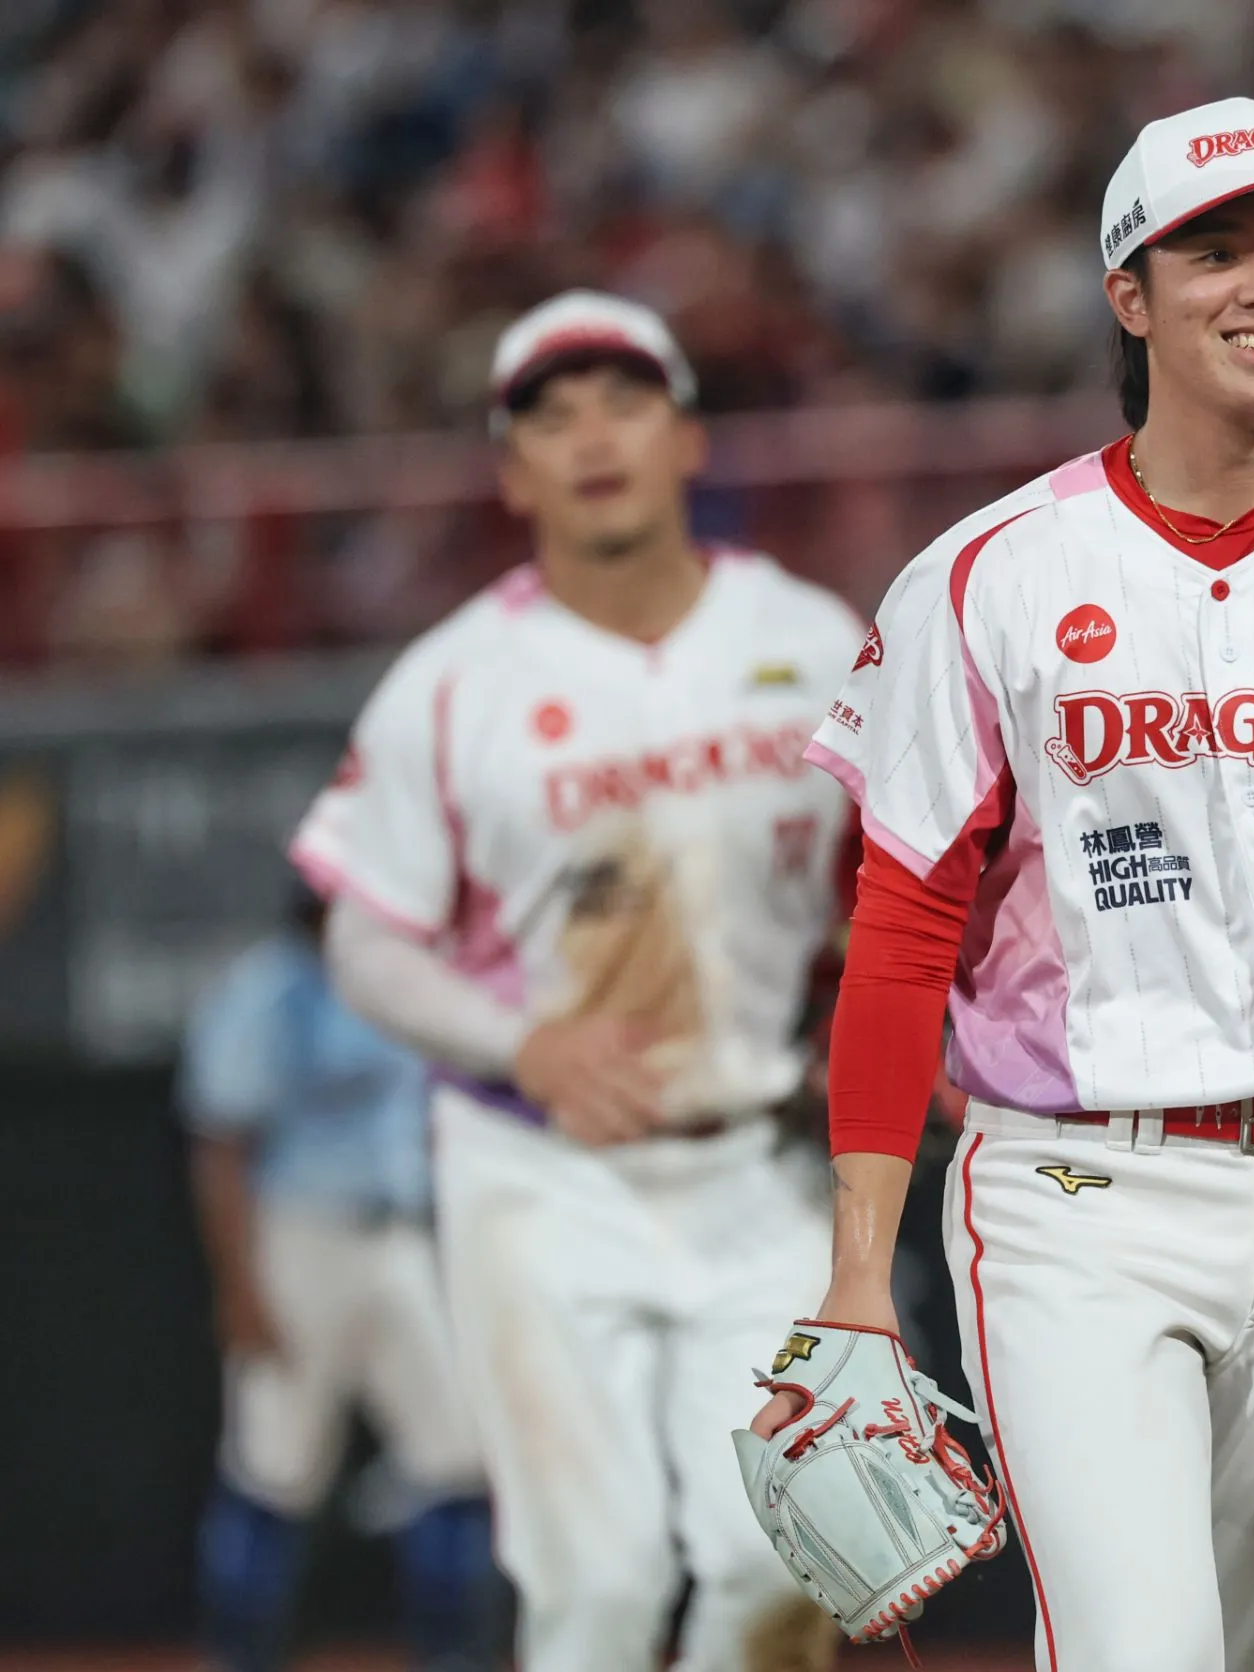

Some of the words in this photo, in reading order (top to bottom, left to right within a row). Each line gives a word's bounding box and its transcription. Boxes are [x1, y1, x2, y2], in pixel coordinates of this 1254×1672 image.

[1080, 822, 1162, 858] 林鳳營
[1088, 854, 1148, 886] HIGH
[1147, 855, 1191, 873] 高品質
[1094, 877, 1192, 912] QUALITY
